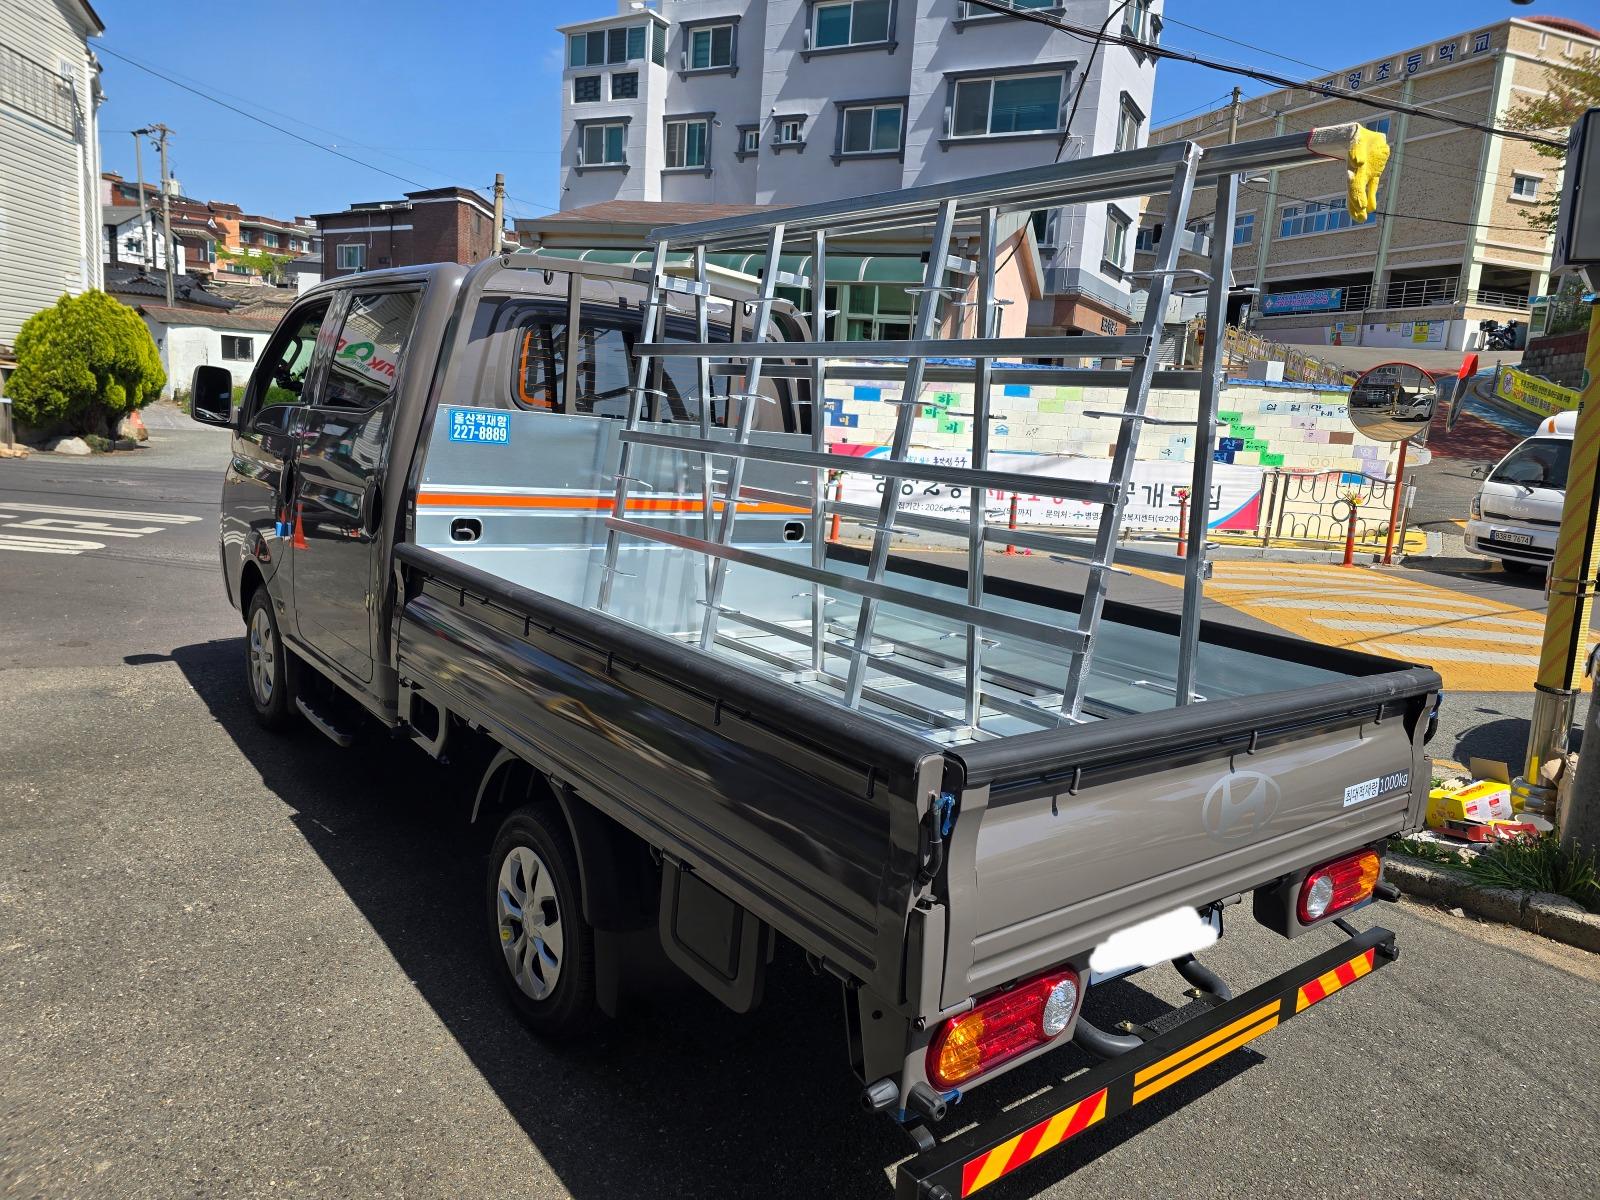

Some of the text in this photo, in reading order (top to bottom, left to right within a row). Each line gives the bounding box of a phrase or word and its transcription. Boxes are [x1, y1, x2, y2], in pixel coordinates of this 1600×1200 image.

[454, 412, 507, 427] 울산적재함
[453, 425, 507, 441] 227-8889
[1345, 772, 1408, 803] 최대적재량 1000kg
